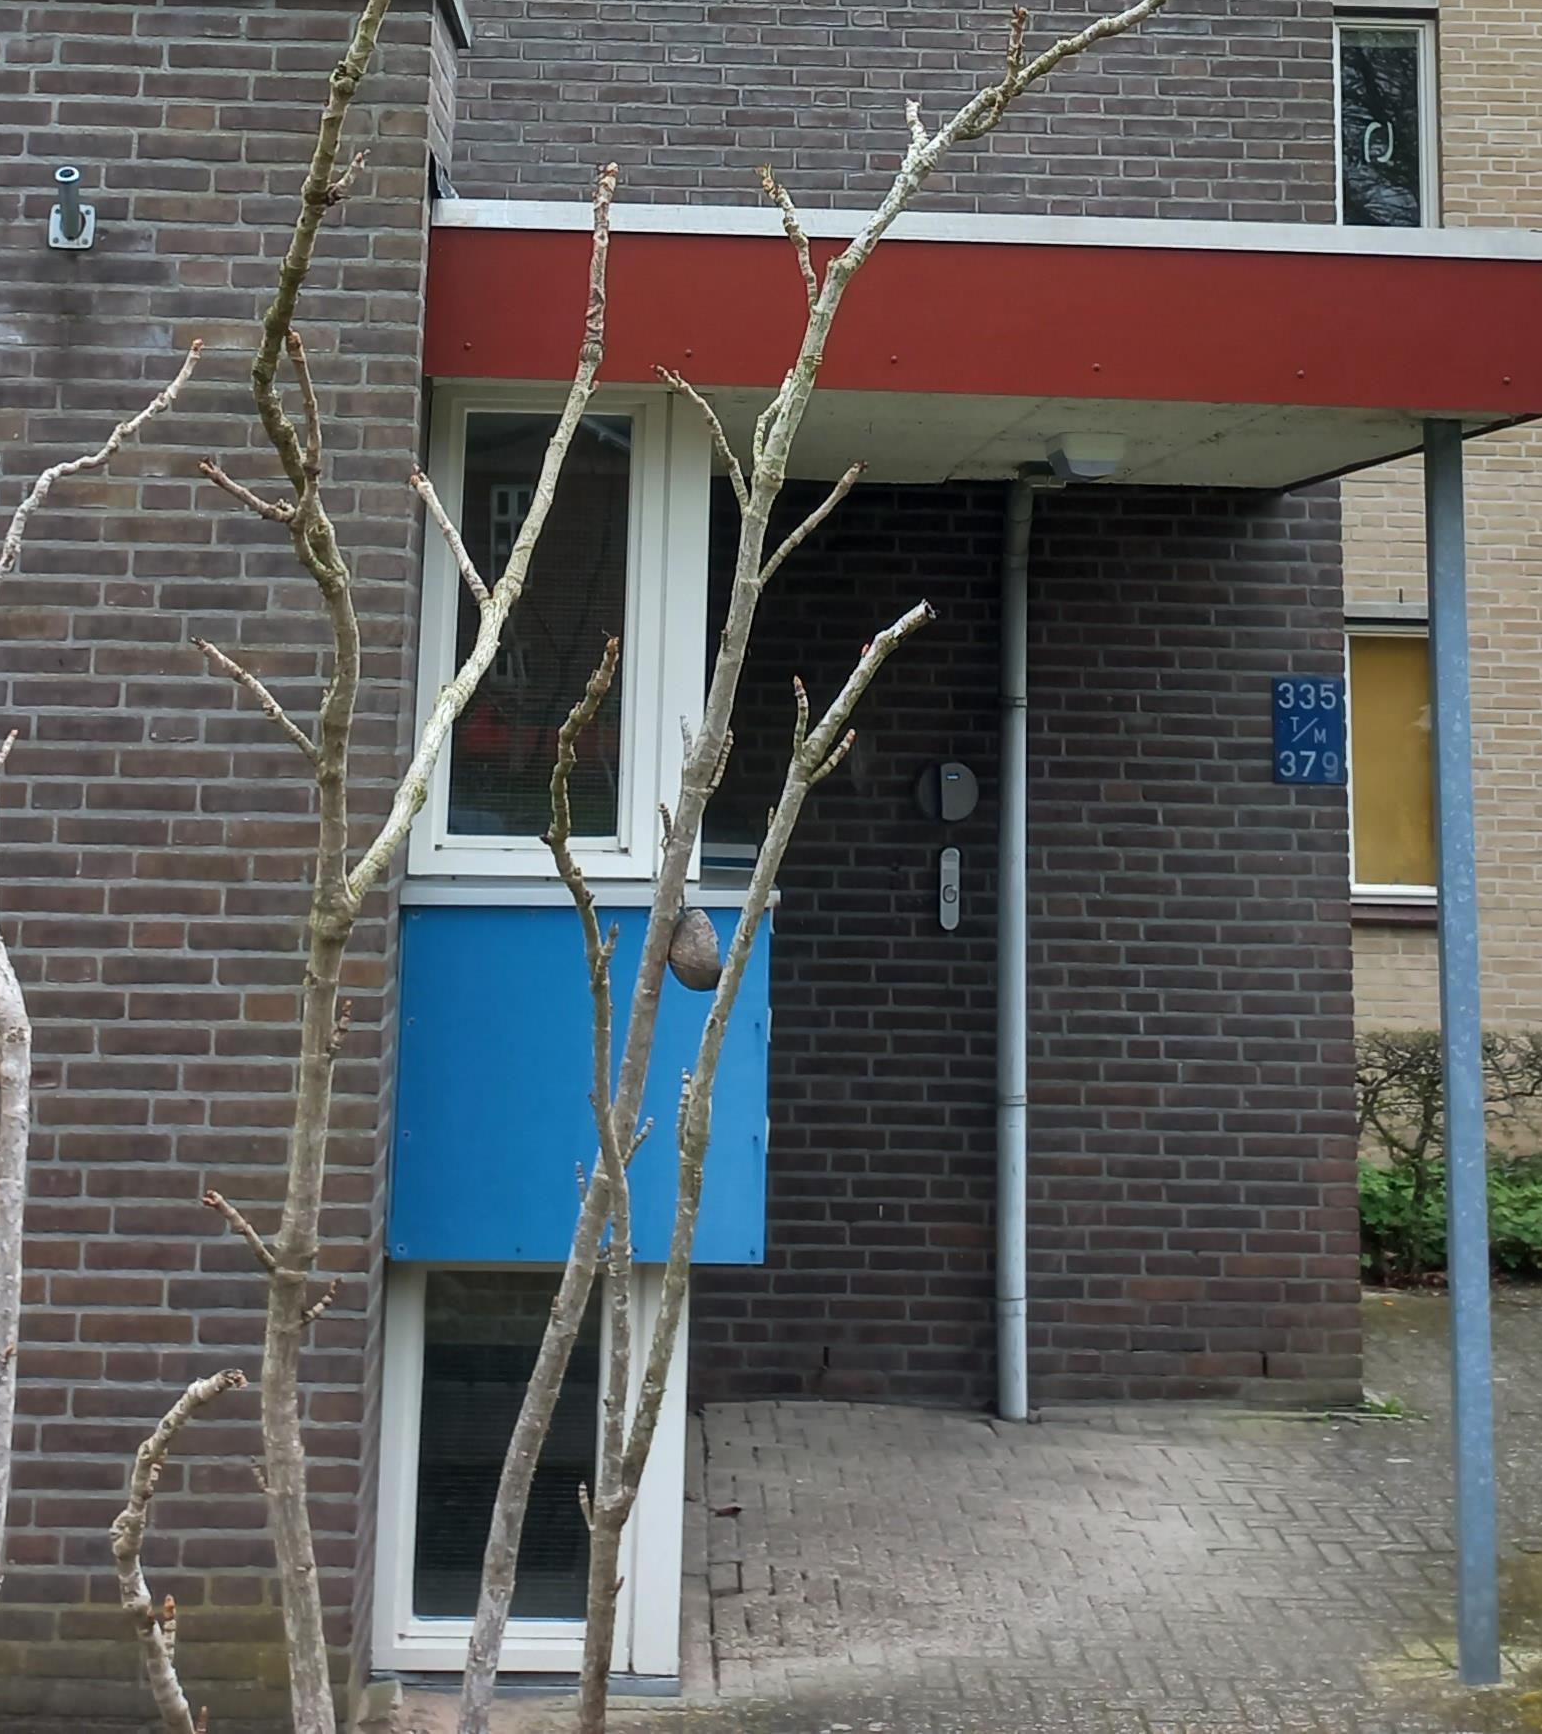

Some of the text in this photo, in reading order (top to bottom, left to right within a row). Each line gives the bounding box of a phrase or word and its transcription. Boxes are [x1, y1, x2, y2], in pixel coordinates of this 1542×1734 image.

[1278, 682, 1336, 709] 335
[1290, 716, 1326, 743] T/M
[1279, 750, 1338, 778] 379
